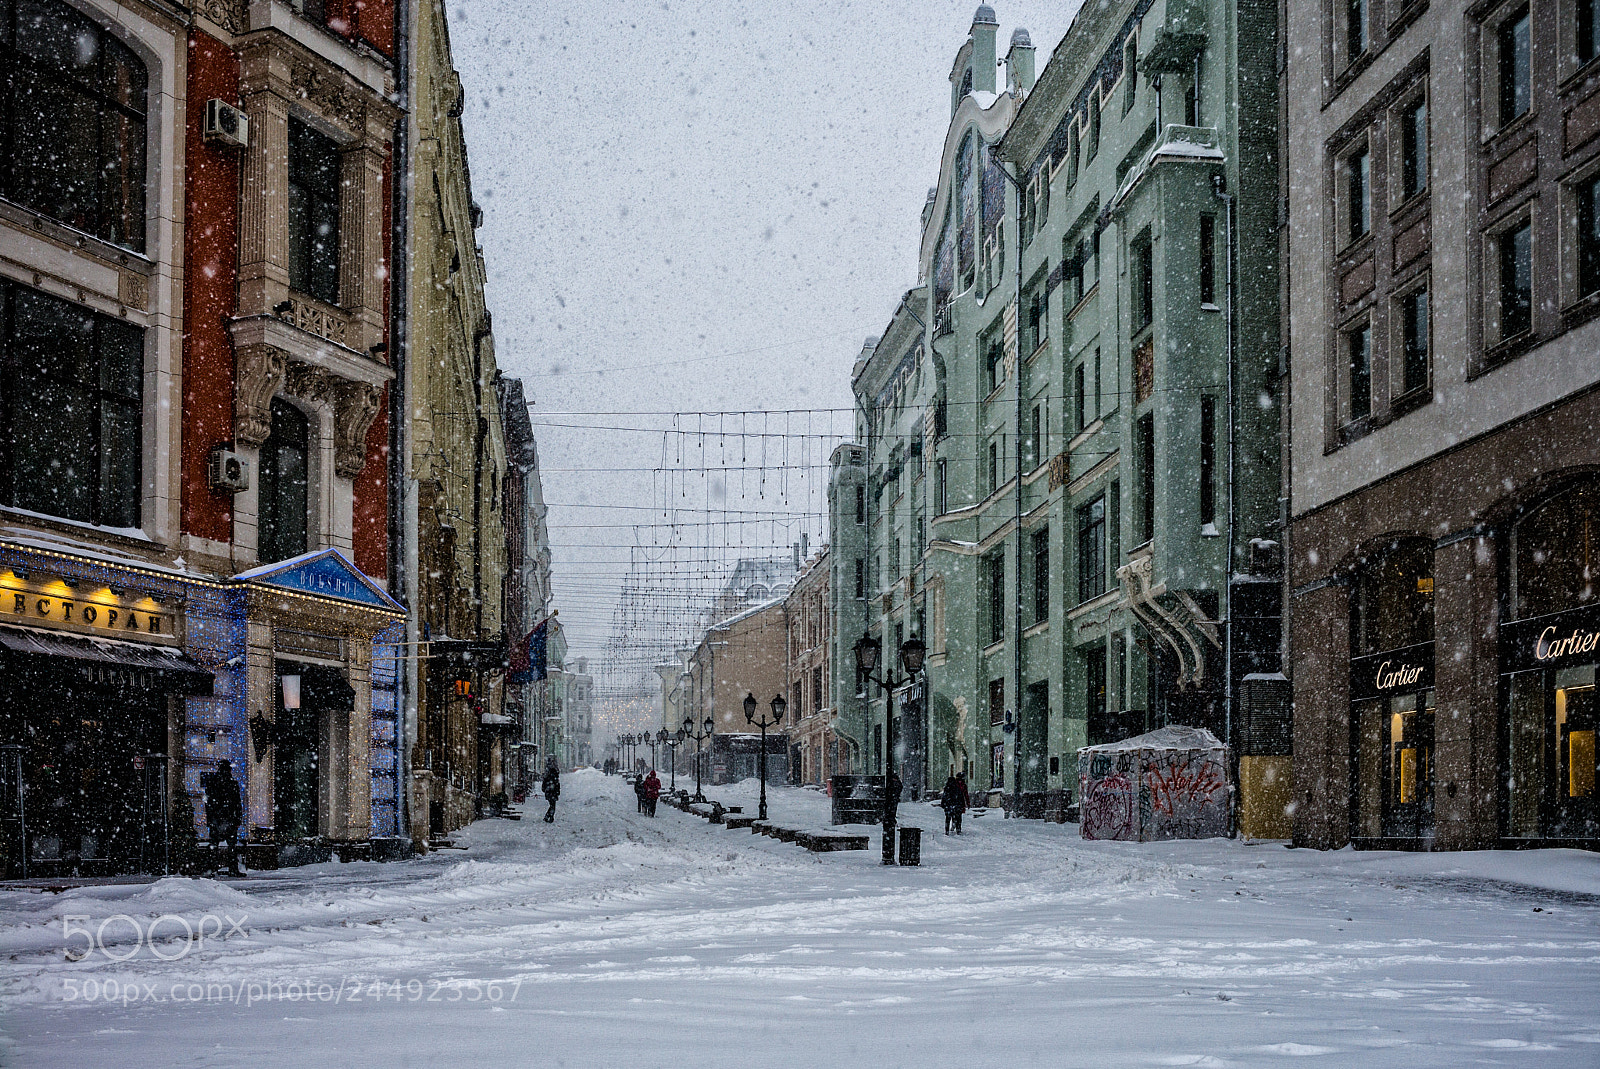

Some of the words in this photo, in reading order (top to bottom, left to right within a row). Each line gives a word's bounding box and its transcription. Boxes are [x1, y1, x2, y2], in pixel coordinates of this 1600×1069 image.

[0, 593, 161, 634] ЕСТОРАН
[1536, 625, 1600, 660] Cartier
[1376, 661, 1424, 690] Cartier
